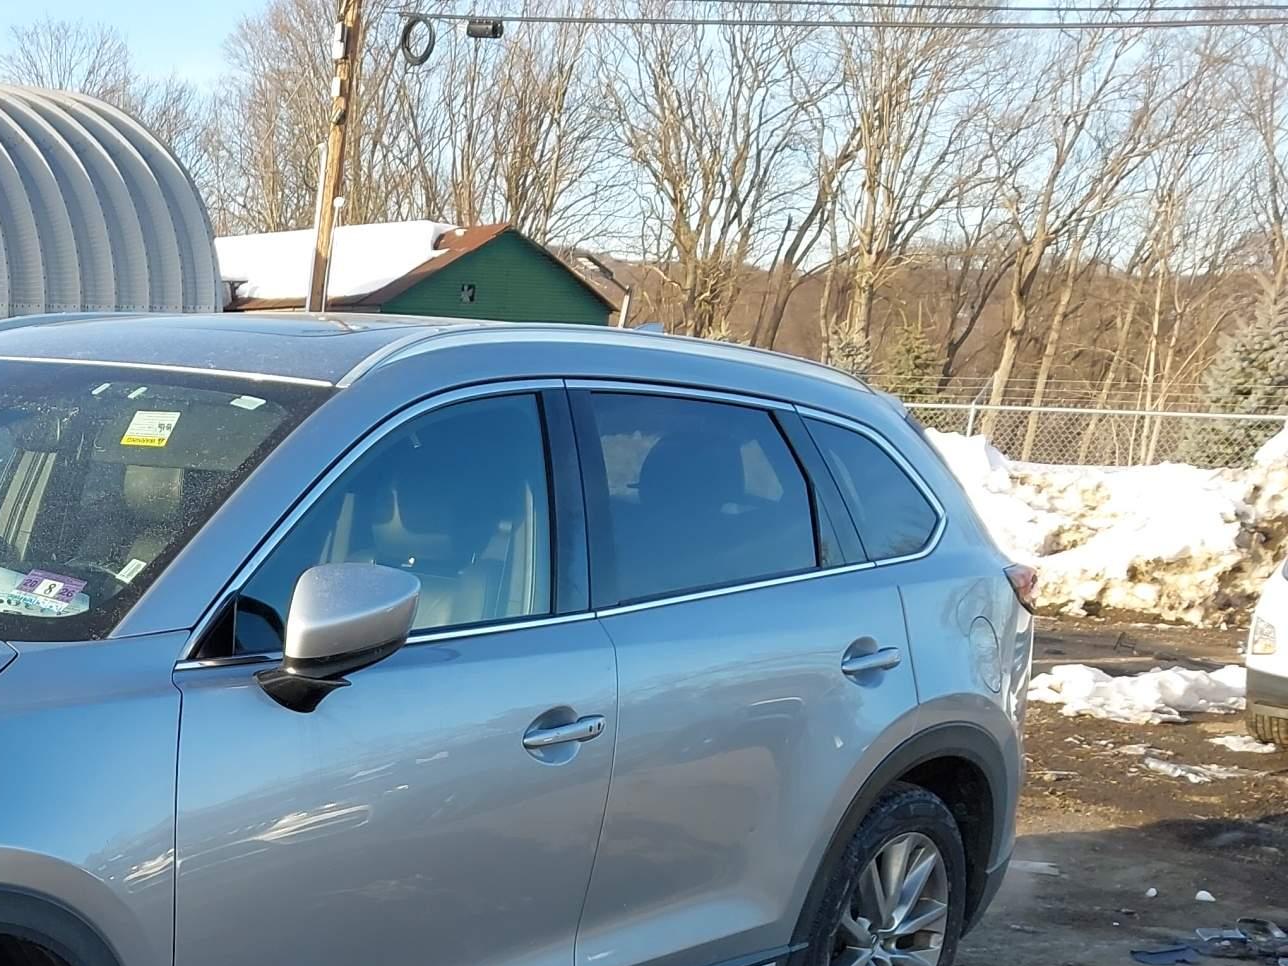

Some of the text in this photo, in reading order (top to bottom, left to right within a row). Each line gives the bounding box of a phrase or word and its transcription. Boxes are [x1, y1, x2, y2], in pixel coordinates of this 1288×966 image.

[23, 578, 75, 598] 20 8 26
